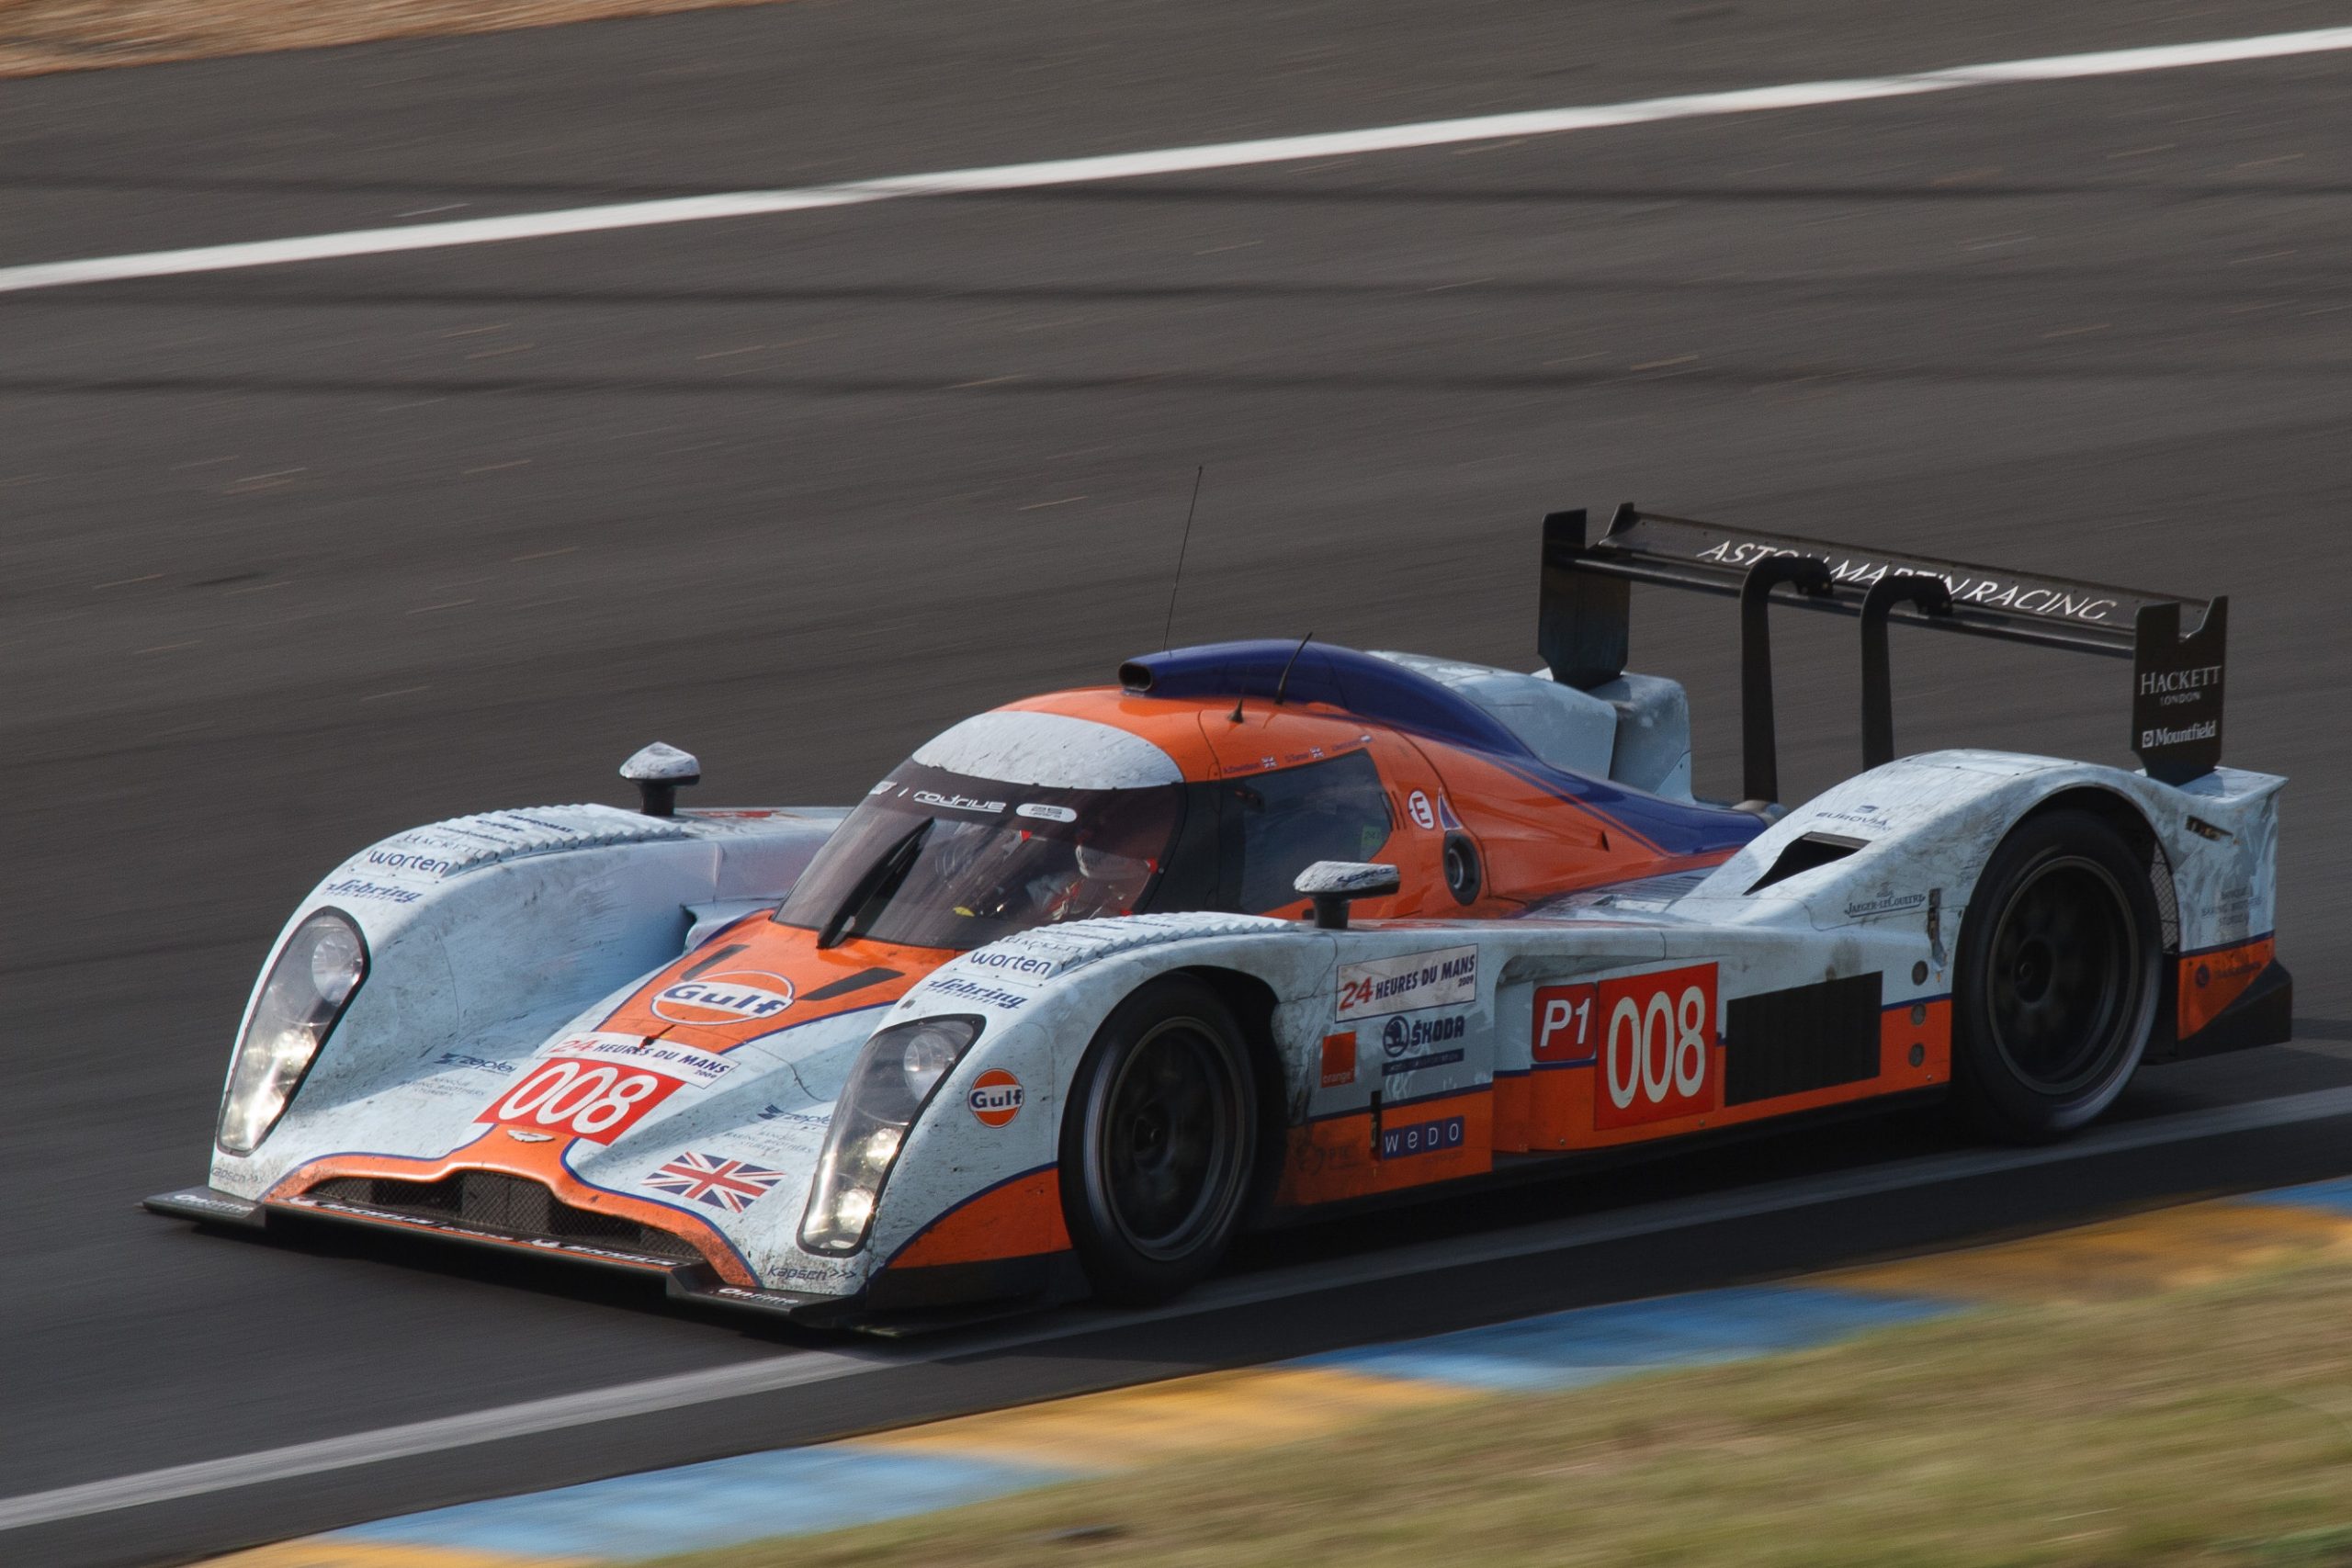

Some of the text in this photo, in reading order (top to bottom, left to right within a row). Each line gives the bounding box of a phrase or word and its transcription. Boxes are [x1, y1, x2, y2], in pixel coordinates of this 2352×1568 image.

[1696, 539, 2118, 620] AST MAN RACING
[2140, 665, 2222, 695] HACKETT
[2154, 719, 2217, 747] Mountfield
[1411, 796, 1431, 825] E
[368, 850, 449, 874] worten
[970, 950, 1051, 976] worten
[928, 977, 1028, 1009] Sebring
[1339, 953, 1476, 1011] 24 HEURES DU MANS
[1458, 974, 1475, 988] 2009
[663, 985, 786, 1014] Gulf
[1539, 998, 1590, 1047] P1
[549, 1039, 731, 1074] 24 HEURES DU MANS
[1608, 986, 1706, 1109] 008
[693, 1069, 718, 1079] 2009
[498, 1062, 659, 1134] 008
[970, 1089, 1023, 1109] Gulf
[766, 1264, 828, 1281] kapsch
